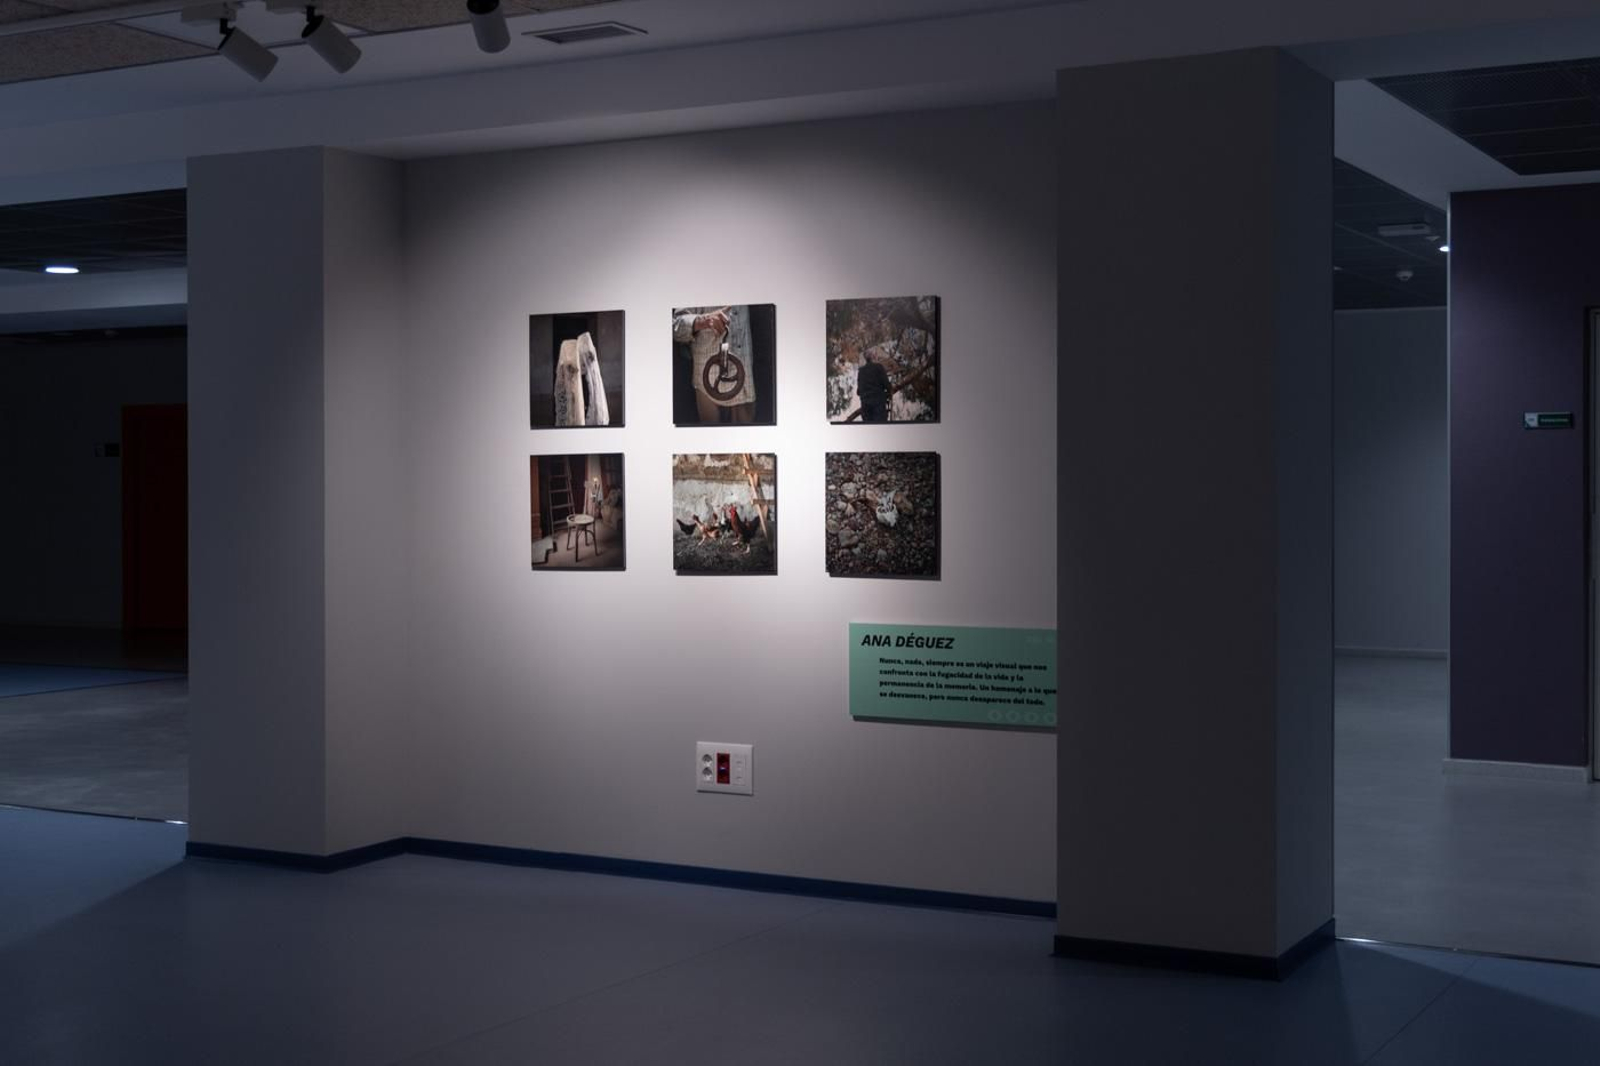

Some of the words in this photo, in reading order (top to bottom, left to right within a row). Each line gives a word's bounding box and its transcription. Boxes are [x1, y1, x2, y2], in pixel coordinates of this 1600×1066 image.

[861, 634, 892, 647] ANA
[895, 632, 956, 649] DÉGUEZ
[926, 659, 954, 667] siempre
[938, 670, 973, 679] fugacidad
[991, 685, 1026, 694] homenaje
[889, 691, 928, 700] desvanece,
[970, 696, 1011, 704] desaparece
